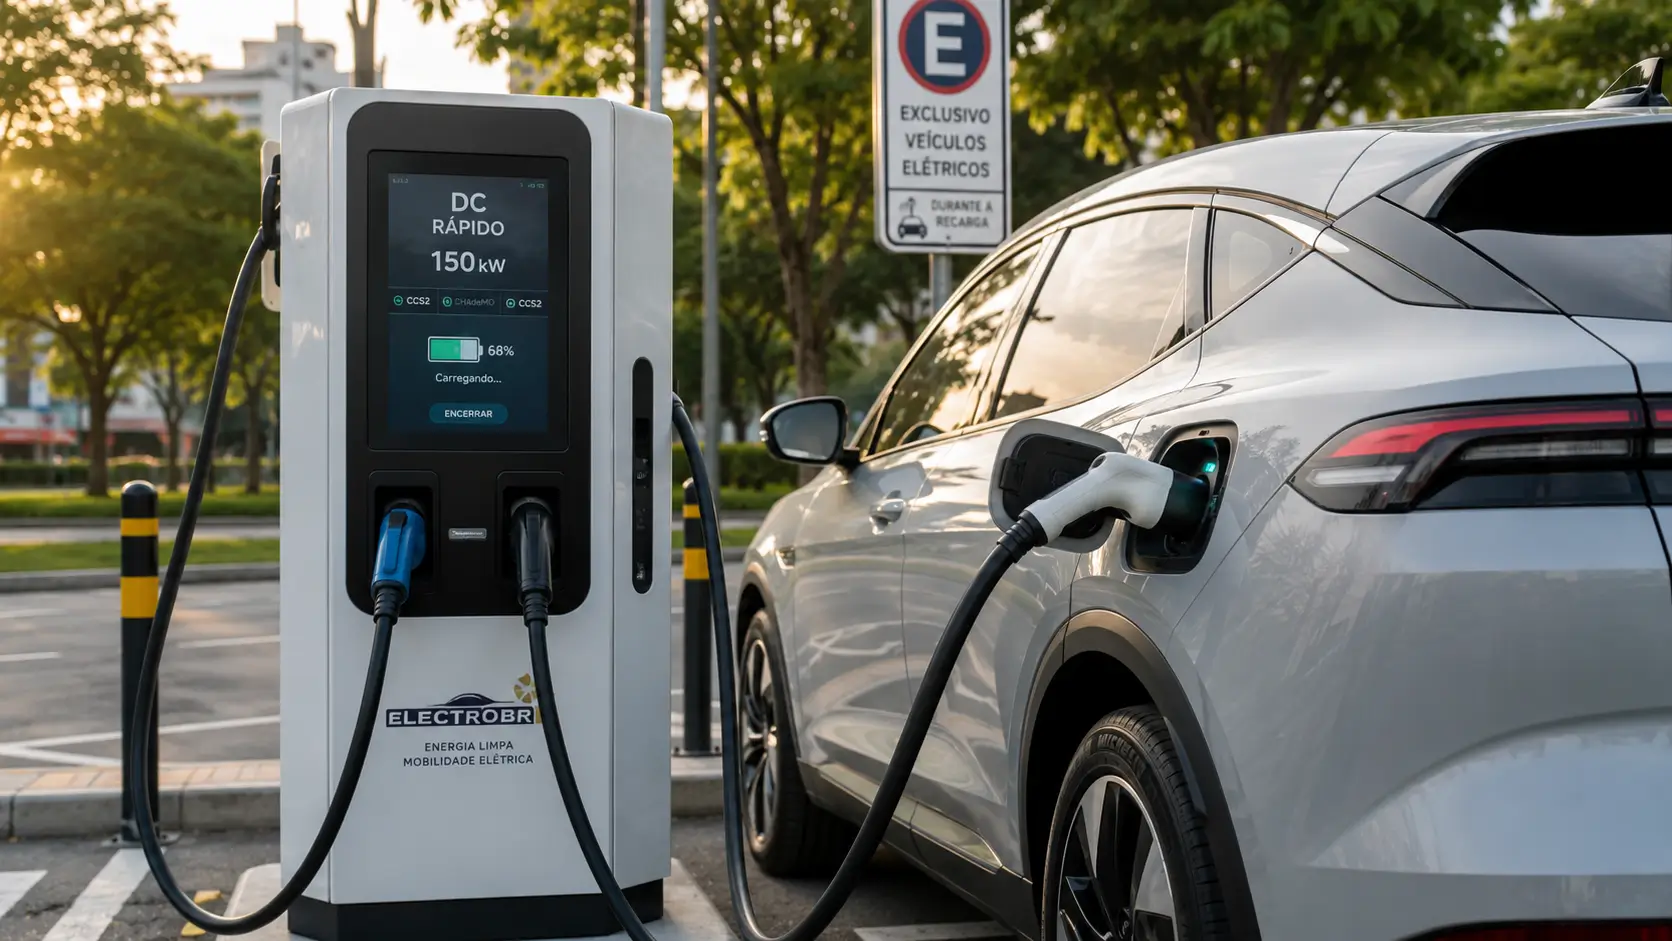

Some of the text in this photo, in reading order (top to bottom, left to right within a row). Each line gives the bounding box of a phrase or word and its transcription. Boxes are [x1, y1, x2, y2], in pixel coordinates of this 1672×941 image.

[924, 10, 966, 76] E
[901, 104, 990, 124] EXCLUSIVO
[905, 129, 987, 152] VEÍCULOS
[902, 156, 990, 178] ELÉTRICOS
[451, 192, 486, 213] DC
[931, 199, 993, 212] DURANTE A
[432, 216, 505, 236] RÁPIDO
[936, 215, 989, 228] RECARGA
[431, 251, 506, 273] 150 kW
[406, 296, 430, 305] CCS2
[518, 299, 542, 308] CCS2
[488, 345, 515, 357] 68%
[435, 373, 502, 385] Carregando...
[444, 409, 493, 418] ENCERRAR
[388, 709, 532, 725] ELECTROBR
[424, 741, 514, 752] ENERGIA LIMPA
[403, 755, 475, 767] MOBILIDADE
